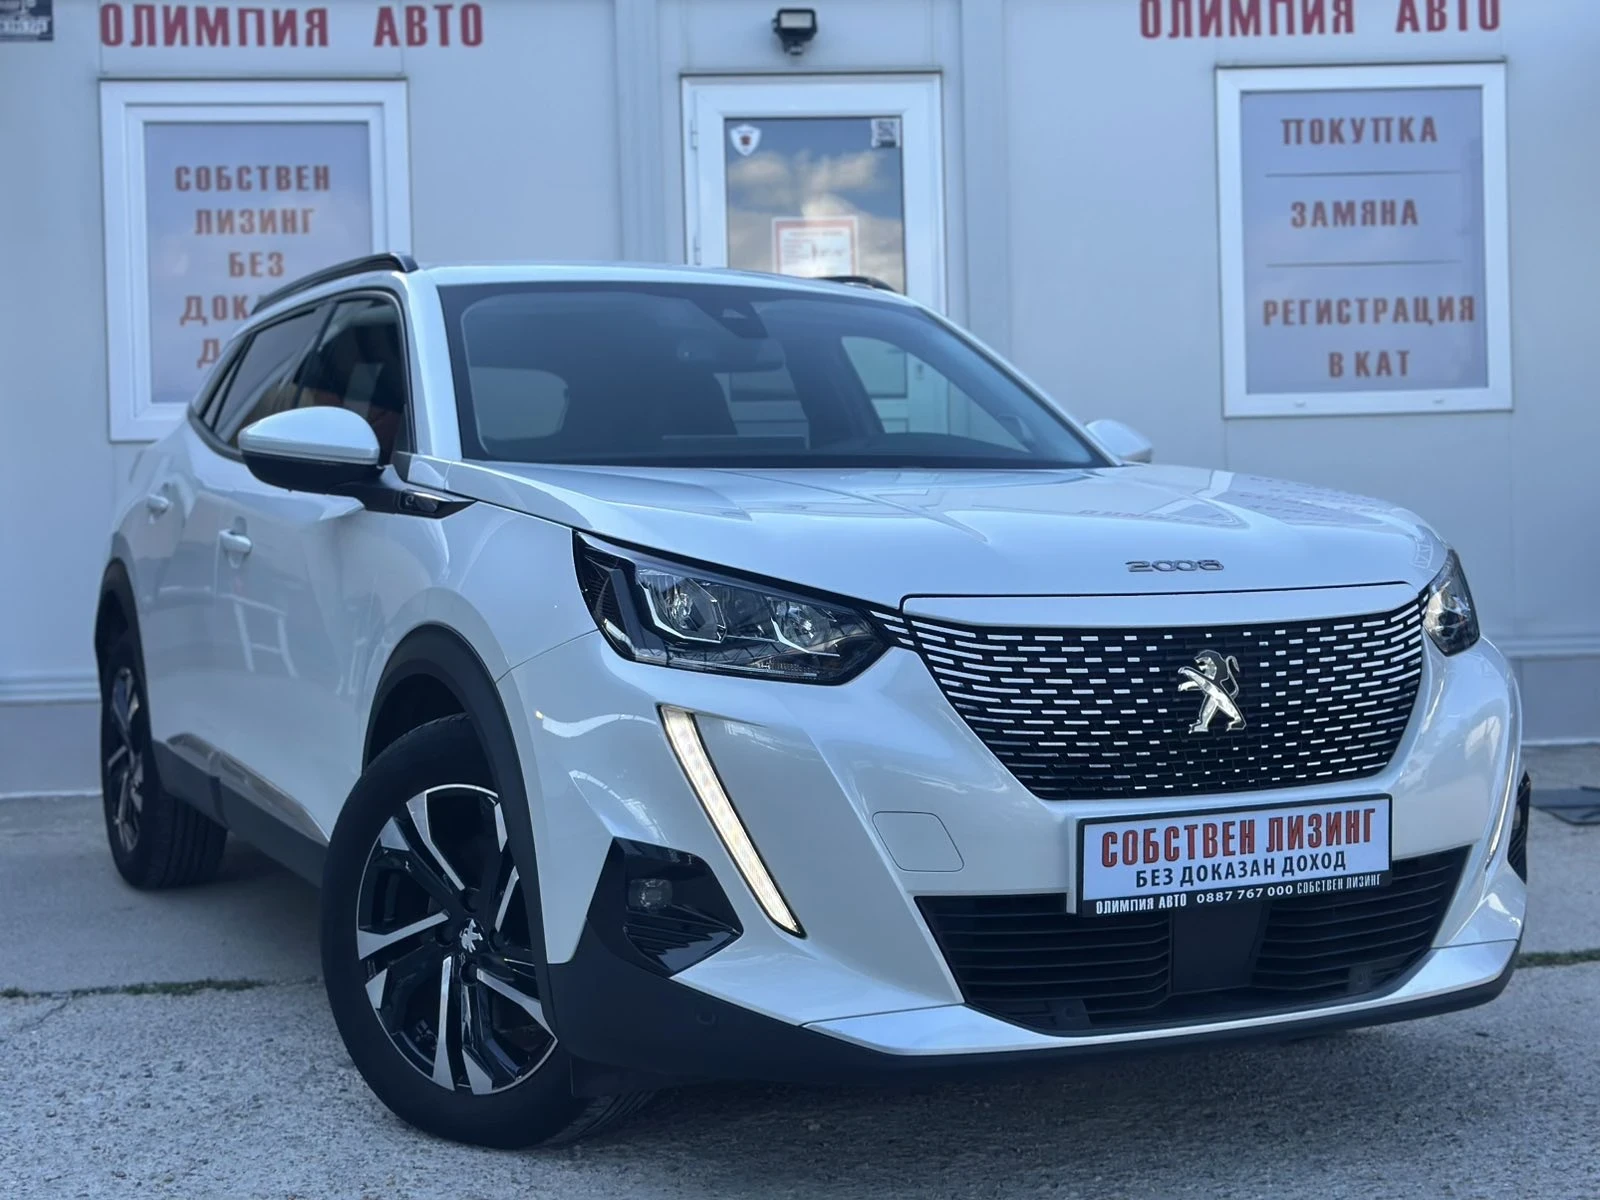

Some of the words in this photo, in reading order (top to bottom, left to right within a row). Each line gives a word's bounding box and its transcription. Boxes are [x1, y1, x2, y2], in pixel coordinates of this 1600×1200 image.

[101, 3, 328, 47] ОЛИМПИЯ
[374, 2, 484, 47] АВТО
[1139, 0, 1355, 39] ОЛИМПИЯ
[1395, 0, 1502, 33] АВТО
[1281, 116, 1438, 146] ПОКУПКА
[175, 165, 331, 192] СОБСТВЕН
[194, 208, 315, 236] ЛИЗИНГ
[1290, 199, 1419, 229] ЗАМЯНА
[228, 251, 284, 279] БЕЗ
[1263, 295, 1476, 327] РЕГИСТРАЦИЯ
[1328, 351, 1344, 379] В
[1355, 349, 1411, 378] КАТ
[1125, 559, 1225, 573] 2008
[1101, 819, 1256, 868] СОБСТВЕН
[1265, 808, 1377, 853] ЛИЗИНГ
[1136, 867, 1174, 888] БЕЗ
[1180, 857, 1276, 888] ДОКАЗАН
[1281, 850, 1347, 878] ДОХОД
[1096, 897, 1154, 915] ОЛИМПИЯ
[1158, 893, 1188, 909] АВТО
[1196, 890, 1234, 904] 0887
[1237, 887, 1264, 900] 767
[1267, 884, 1294, 897] 000
[1297, 878, 1344, 895] СОБСТВЕН
[1346, 873, 1382, 890] ЛИЗИНГ
